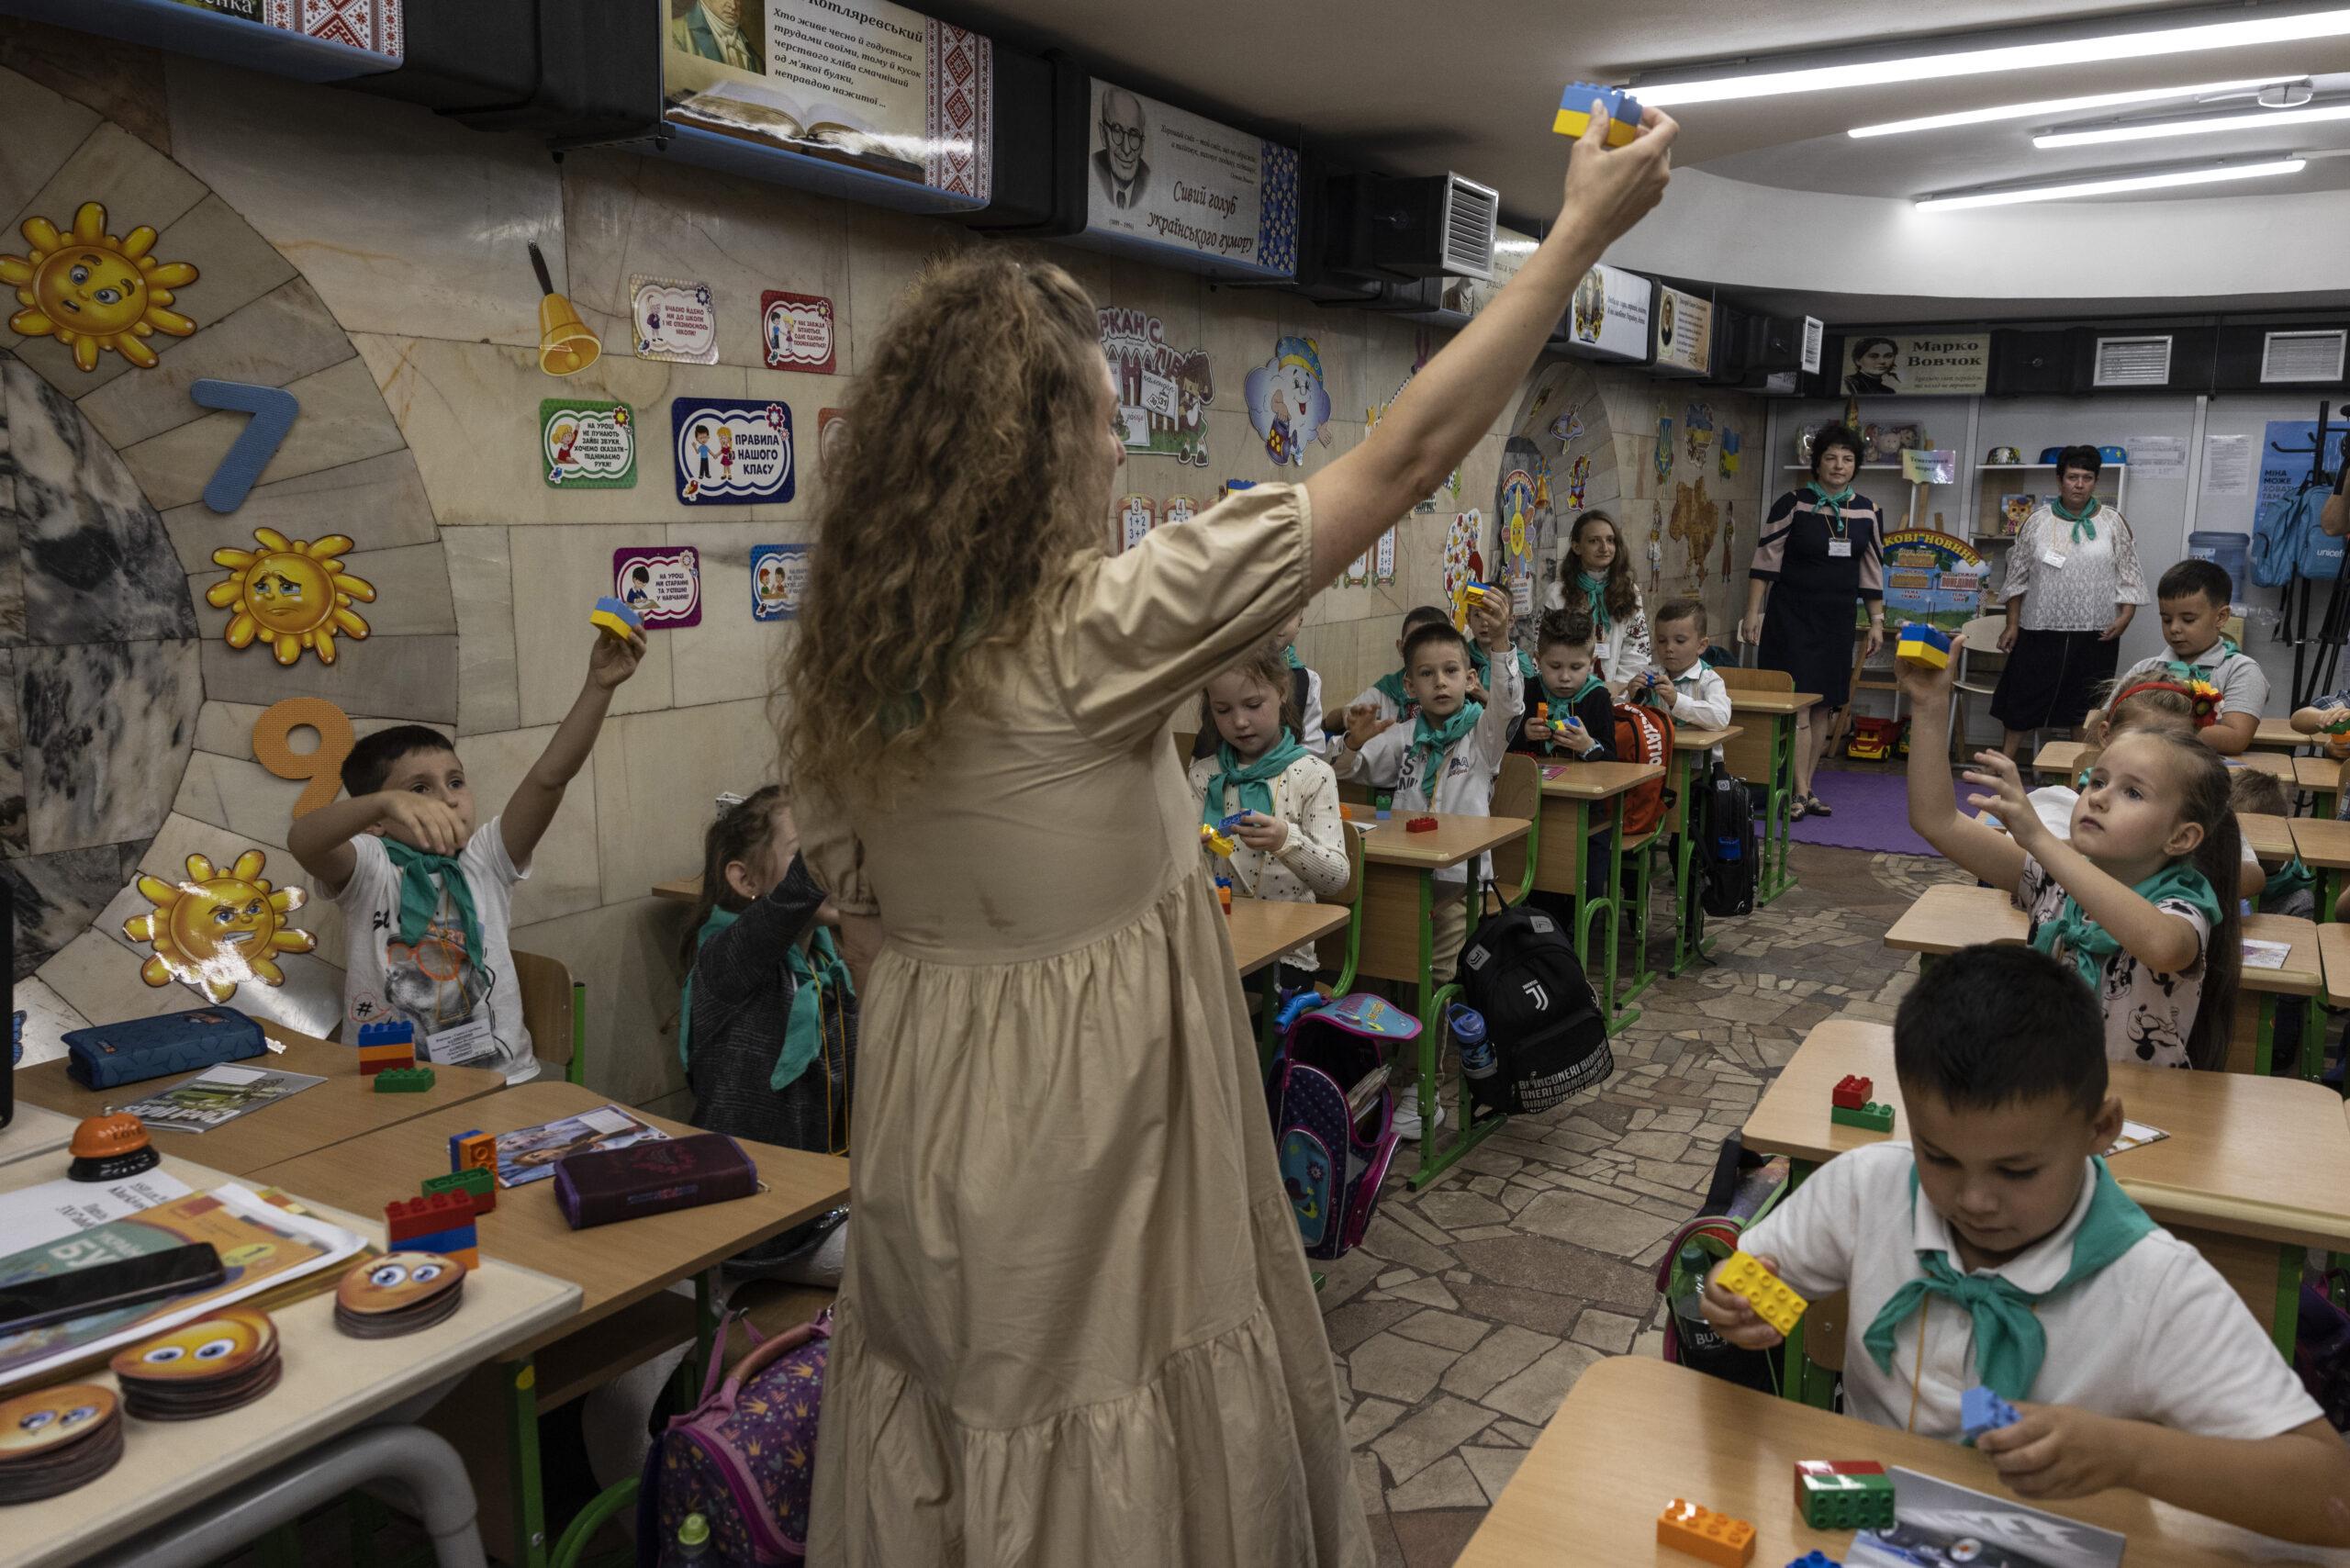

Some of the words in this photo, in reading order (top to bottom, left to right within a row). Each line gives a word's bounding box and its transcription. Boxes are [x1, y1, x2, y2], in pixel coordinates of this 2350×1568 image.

[774, 7, 795, 22] Хто
[798, 17, 827, 32] живе
[829, 28, 856, 42] чесно
[858, 36, 864, 45] й
[866, 40, 912, 62] годується
[809, 0, 923, 43] отляревський
[774, 24, 822, 46] трудами
[824, 41, 859, 59] своїми,
[862, 52, 888, 68] тому
[890, 61, 895, 70] й
[897, 65, 921, 79] кусок
[774, 39, 829, 62] черствого
[830, 57, 856, 71] хліба
[858, 67, 909, 88] смачніший
[774, 53, 787, 63] од
[788, 58, 822, 73] м'якої
[823, 67, 854, 84] булки,
[775, 68, 831, 91] неправдою
[833, 85, 878, 106] нажитої
[1173, 181, 1206, 206] Сивий
[1209, 194, 1238, 218] голуб
[1147, 212, 1216, 250] українського
[1218, 235, 1254, 254] гумору
[1908, 356, 1982, 367] Вовчок
[1913, 342, 1979, 353] Марко
[189, 378, 300, 514] 7
[735, 434, 779, 445] ПРАВИЛА
[738, 449, 778, 460] НАШОГО
[744, 464, 774, 475] КЛАСУ
[1134, 500, 1139, 512] 3
[1178, 500, 1183, 512] 4
[1882, 533, 1919, 548] КОВІ
[1924, 534, 1979, 566] НОВИНИ
[2316, 548, 2344, 557] unicef
[252, 696, 354, 819] 9
